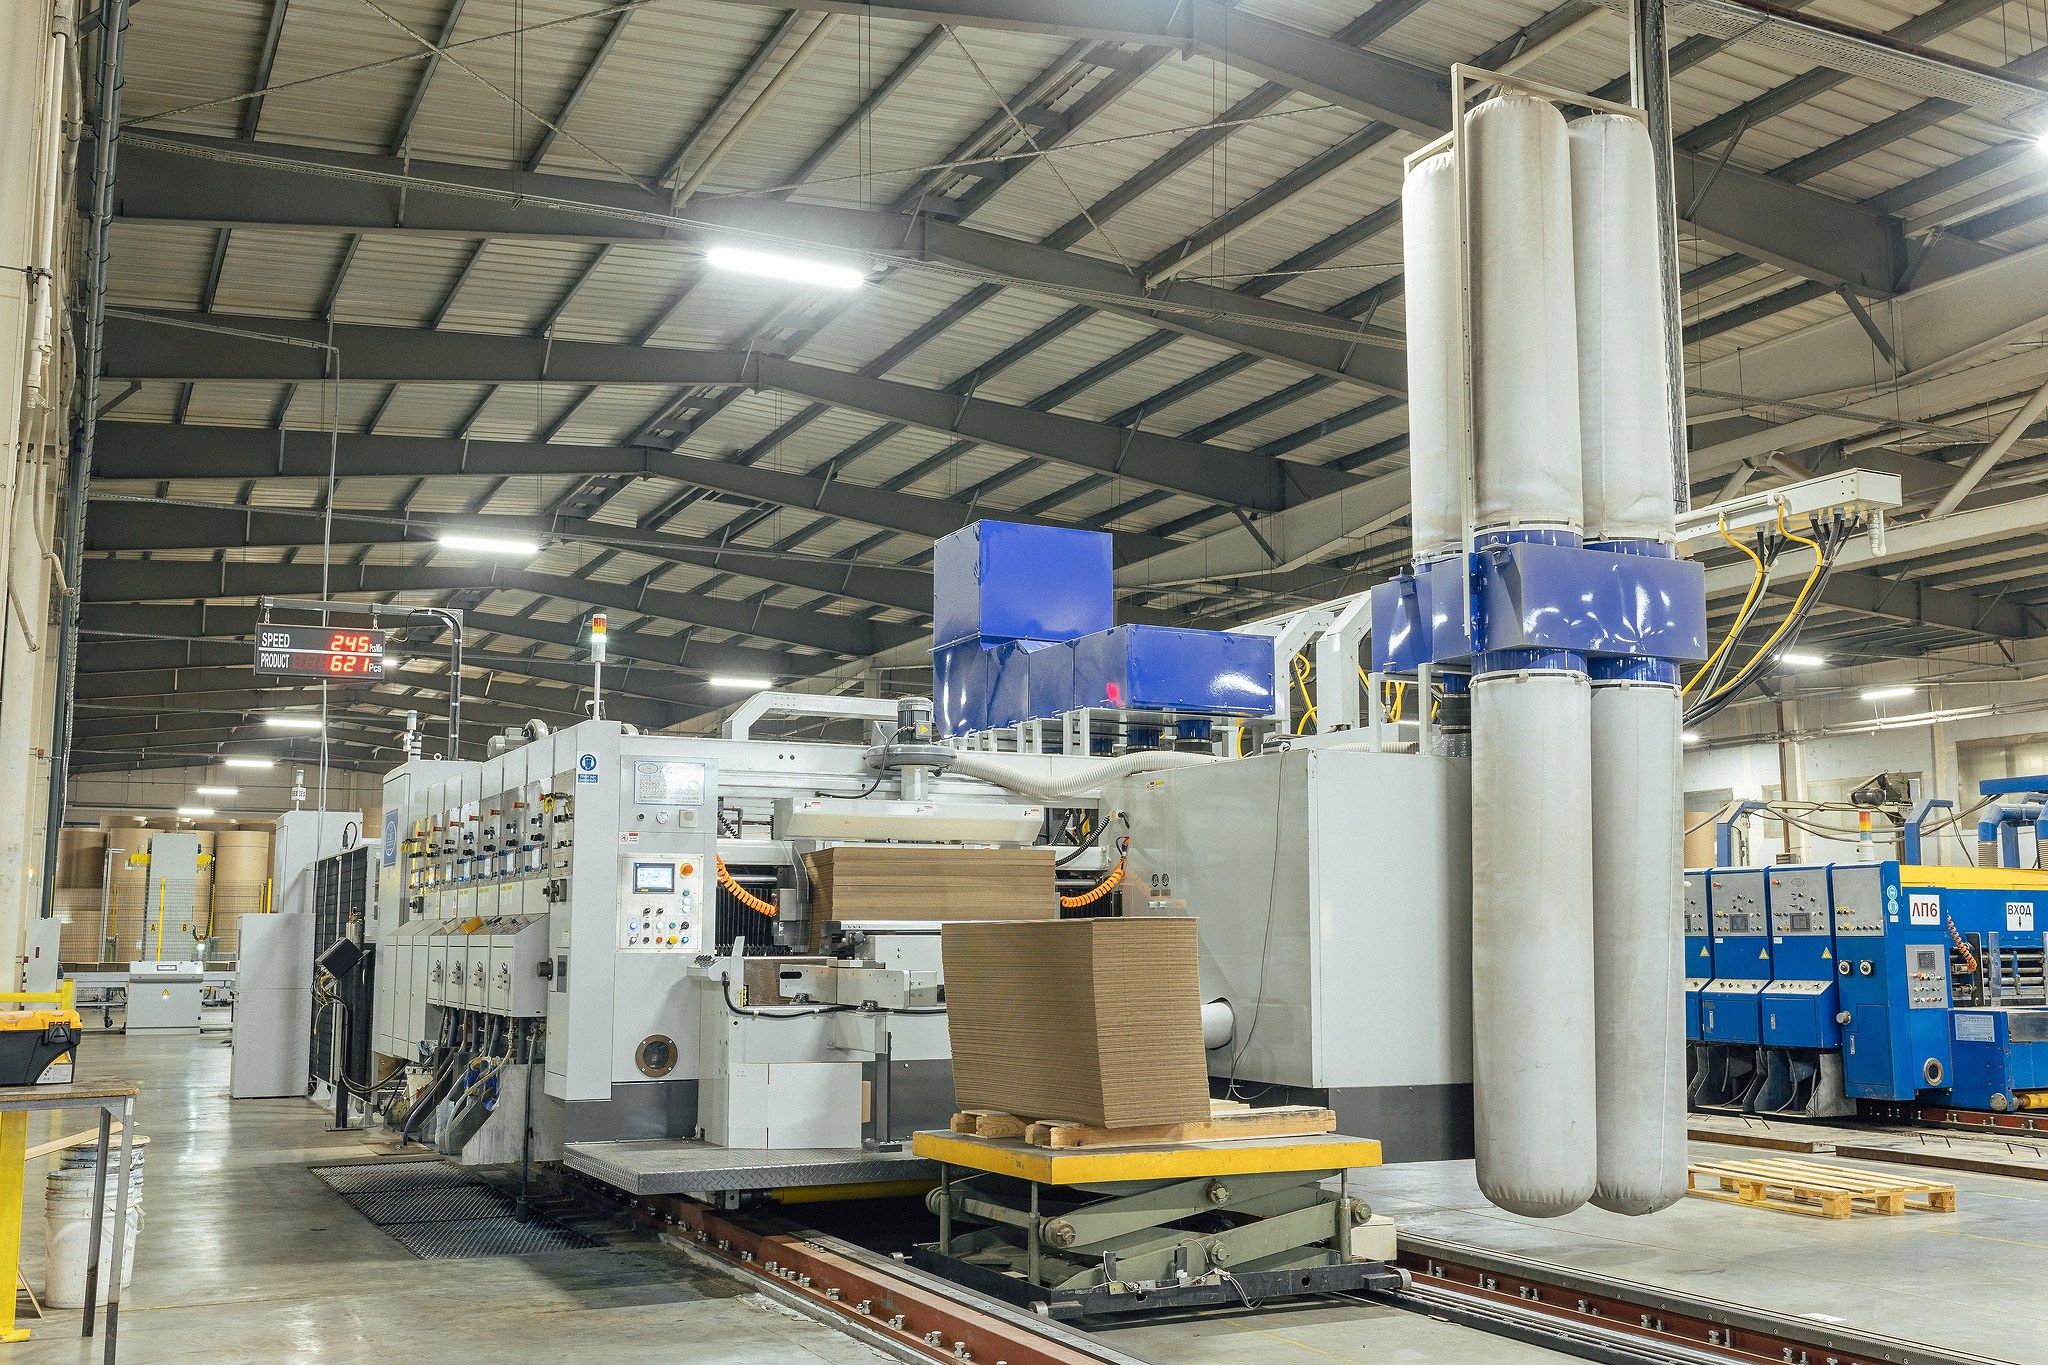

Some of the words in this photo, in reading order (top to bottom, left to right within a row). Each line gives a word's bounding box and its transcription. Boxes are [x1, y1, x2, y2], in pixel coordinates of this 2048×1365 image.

[262, 632, 290, 648] SPEED
[331, 635, 369, 652] 245
[260, 653, 289, 669] PRODUCT
[331, 655, 369, 672] 621
[369, 663, 382, 673] Pcs
[2008, 904, 2032, 917] ВХОД
